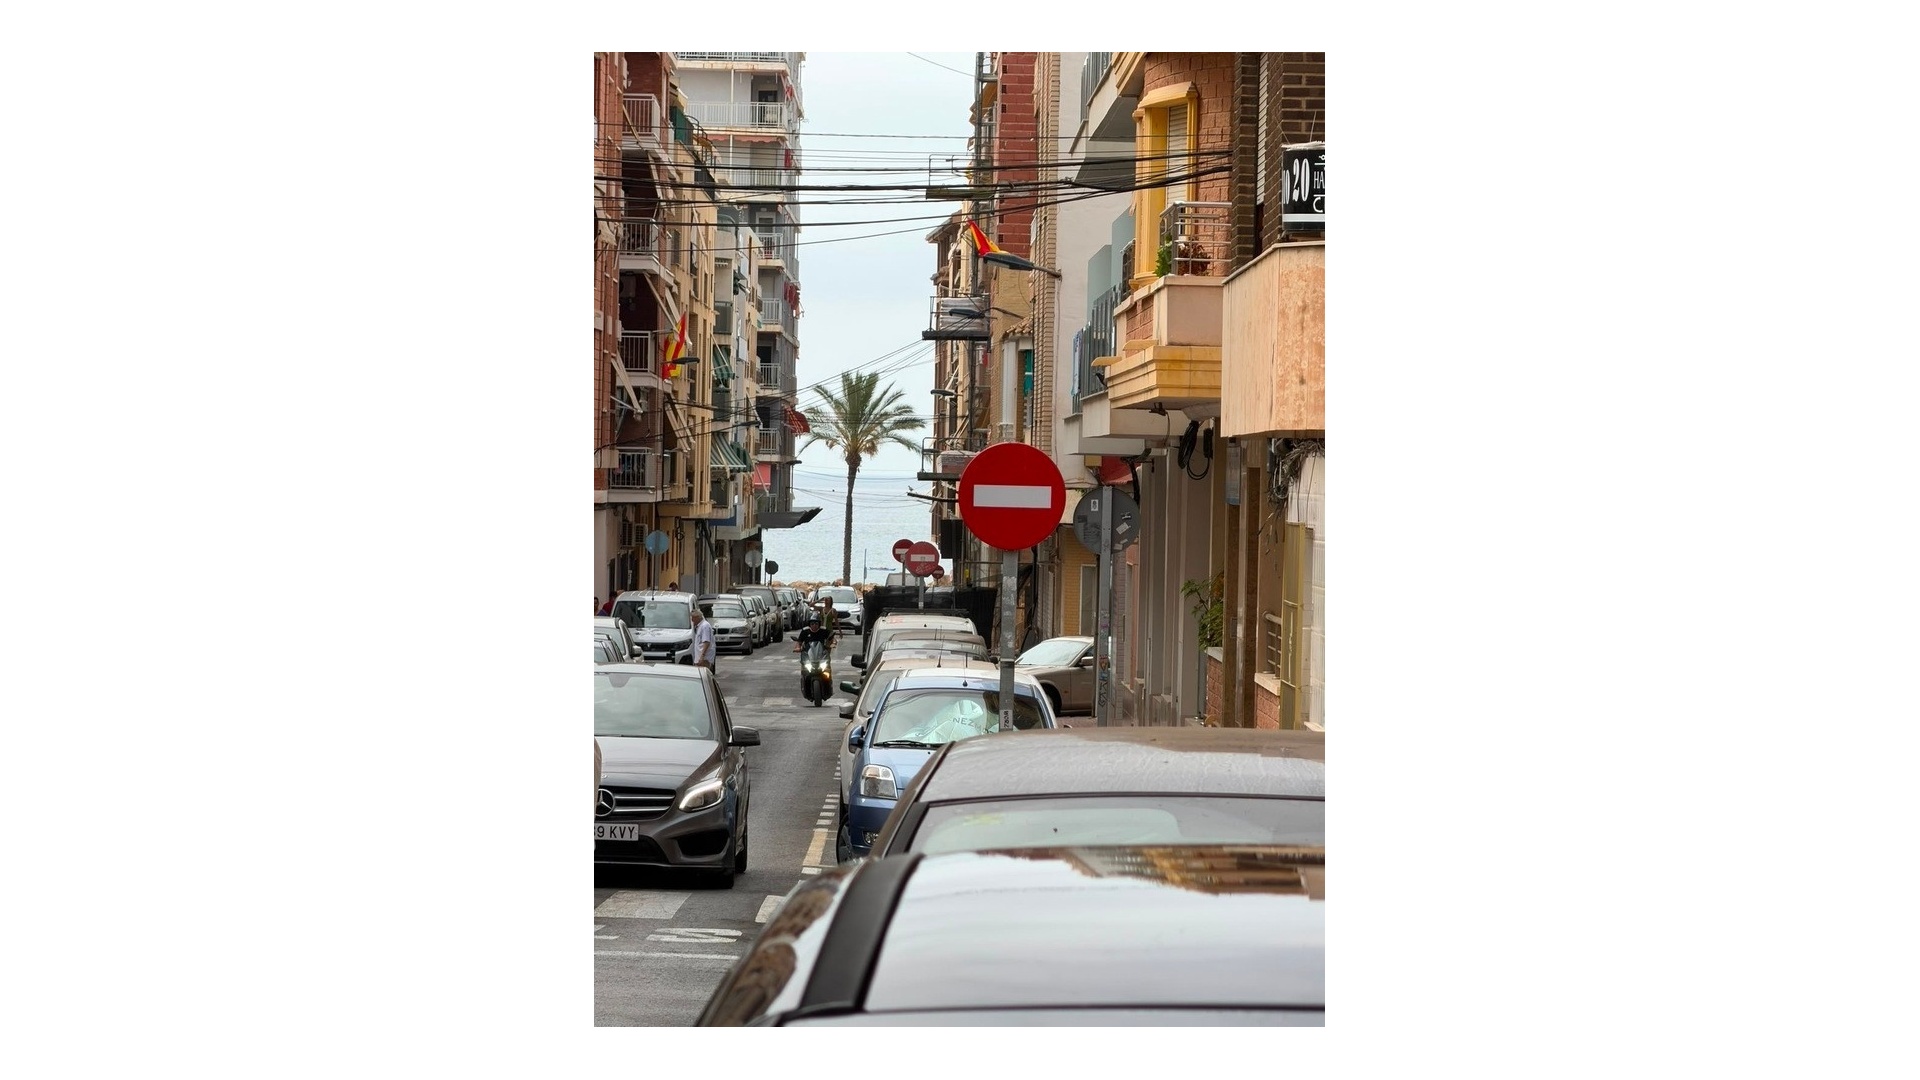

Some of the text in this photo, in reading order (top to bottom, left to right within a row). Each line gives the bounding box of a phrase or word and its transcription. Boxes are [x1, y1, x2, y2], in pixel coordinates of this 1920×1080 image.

[1292, 158, 1310, 202] 20
[1313, 196, 1325, 213] C
[594, 825, 635, 839] 9 KVY
